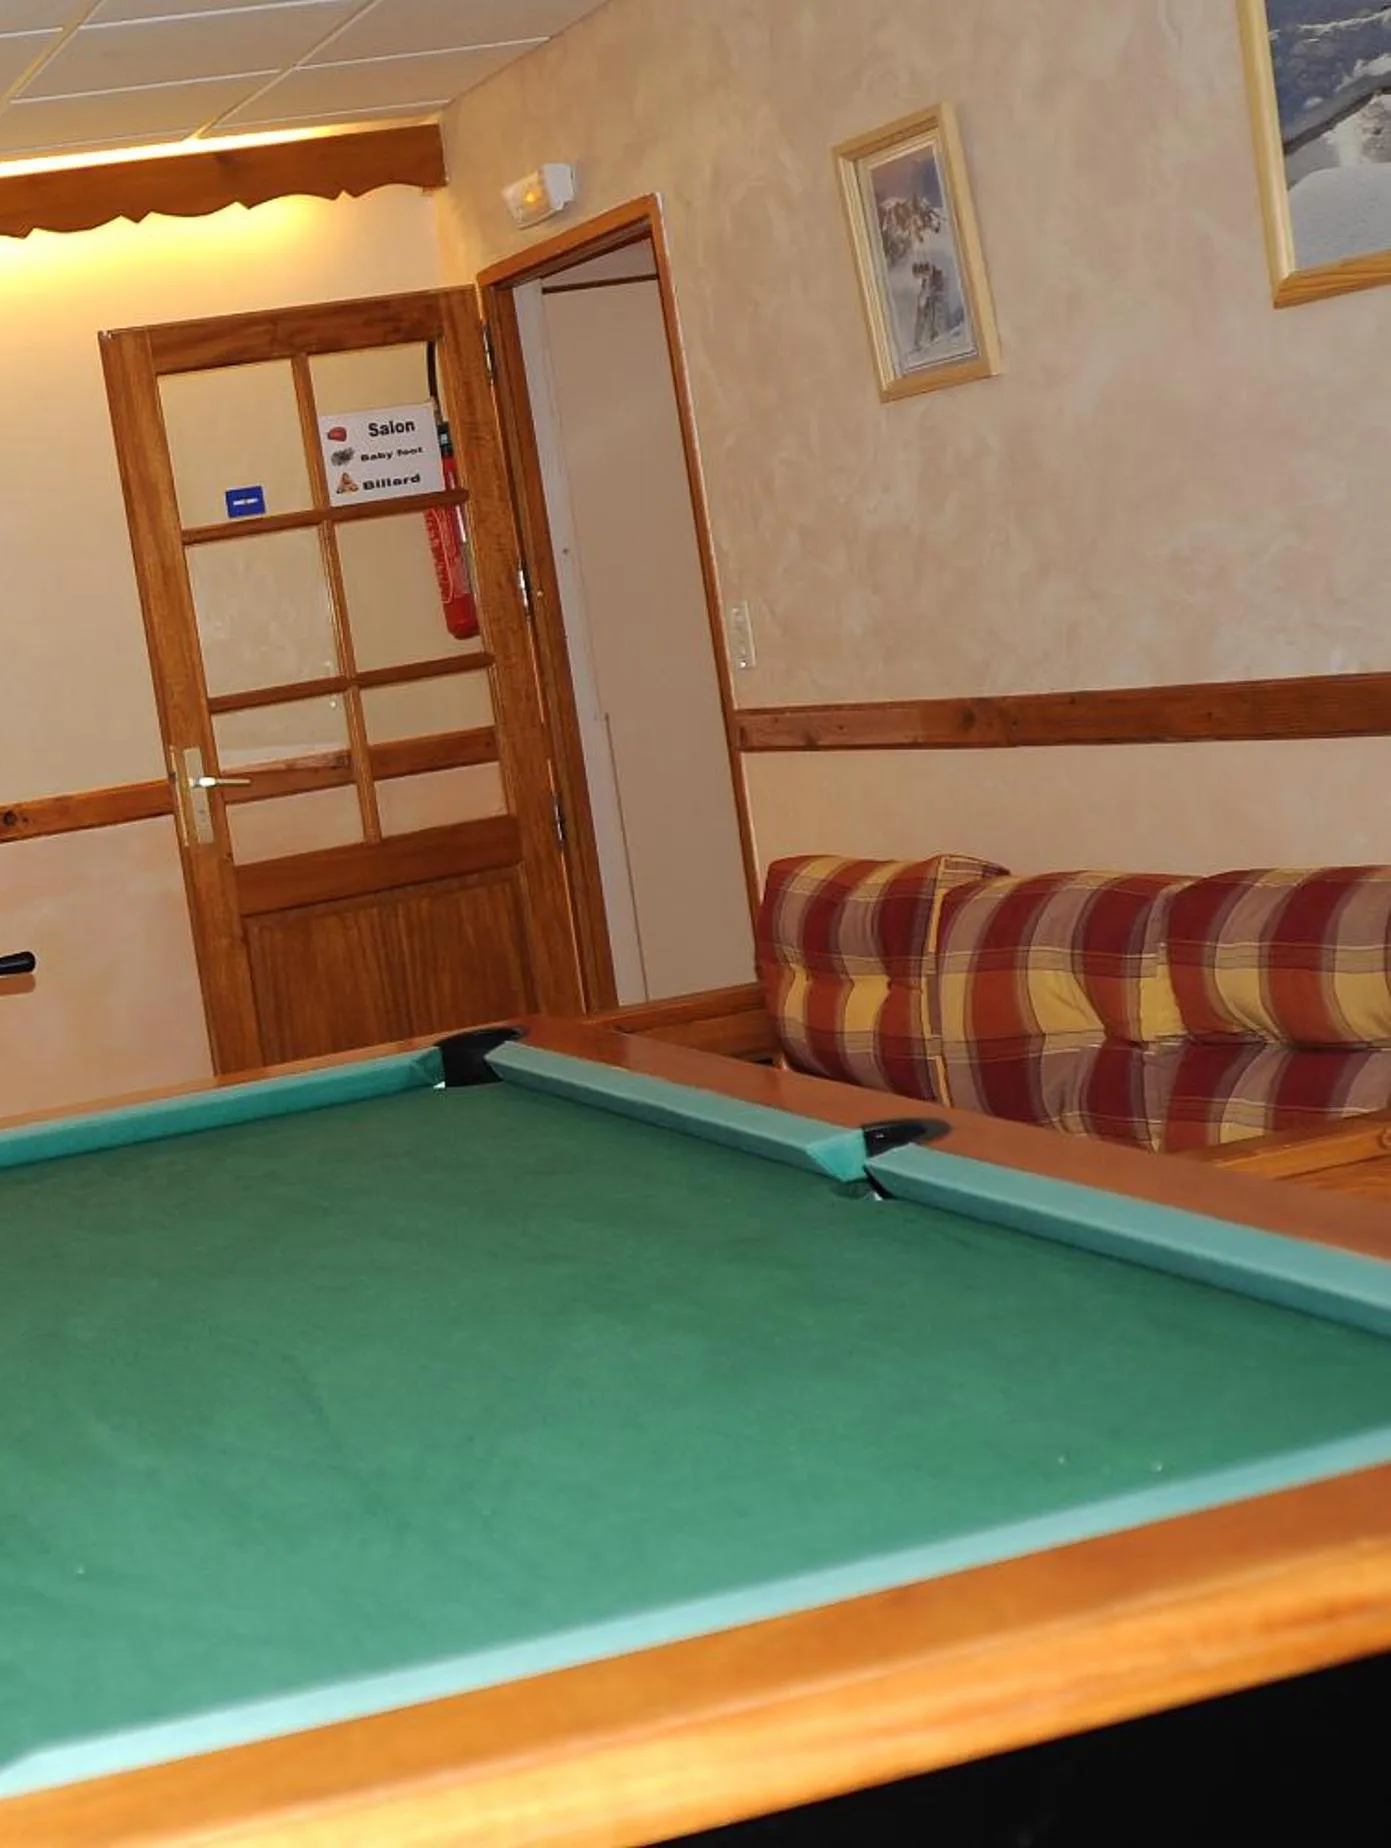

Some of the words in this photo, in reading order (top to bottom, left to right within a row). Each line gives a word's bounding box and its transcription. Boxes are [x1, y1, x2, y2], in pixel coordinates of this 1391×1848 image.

[368, 420, 415, 437] Salon
[360, 451, 393, 462] Baby
[363, 473, 421, 491] Billard
